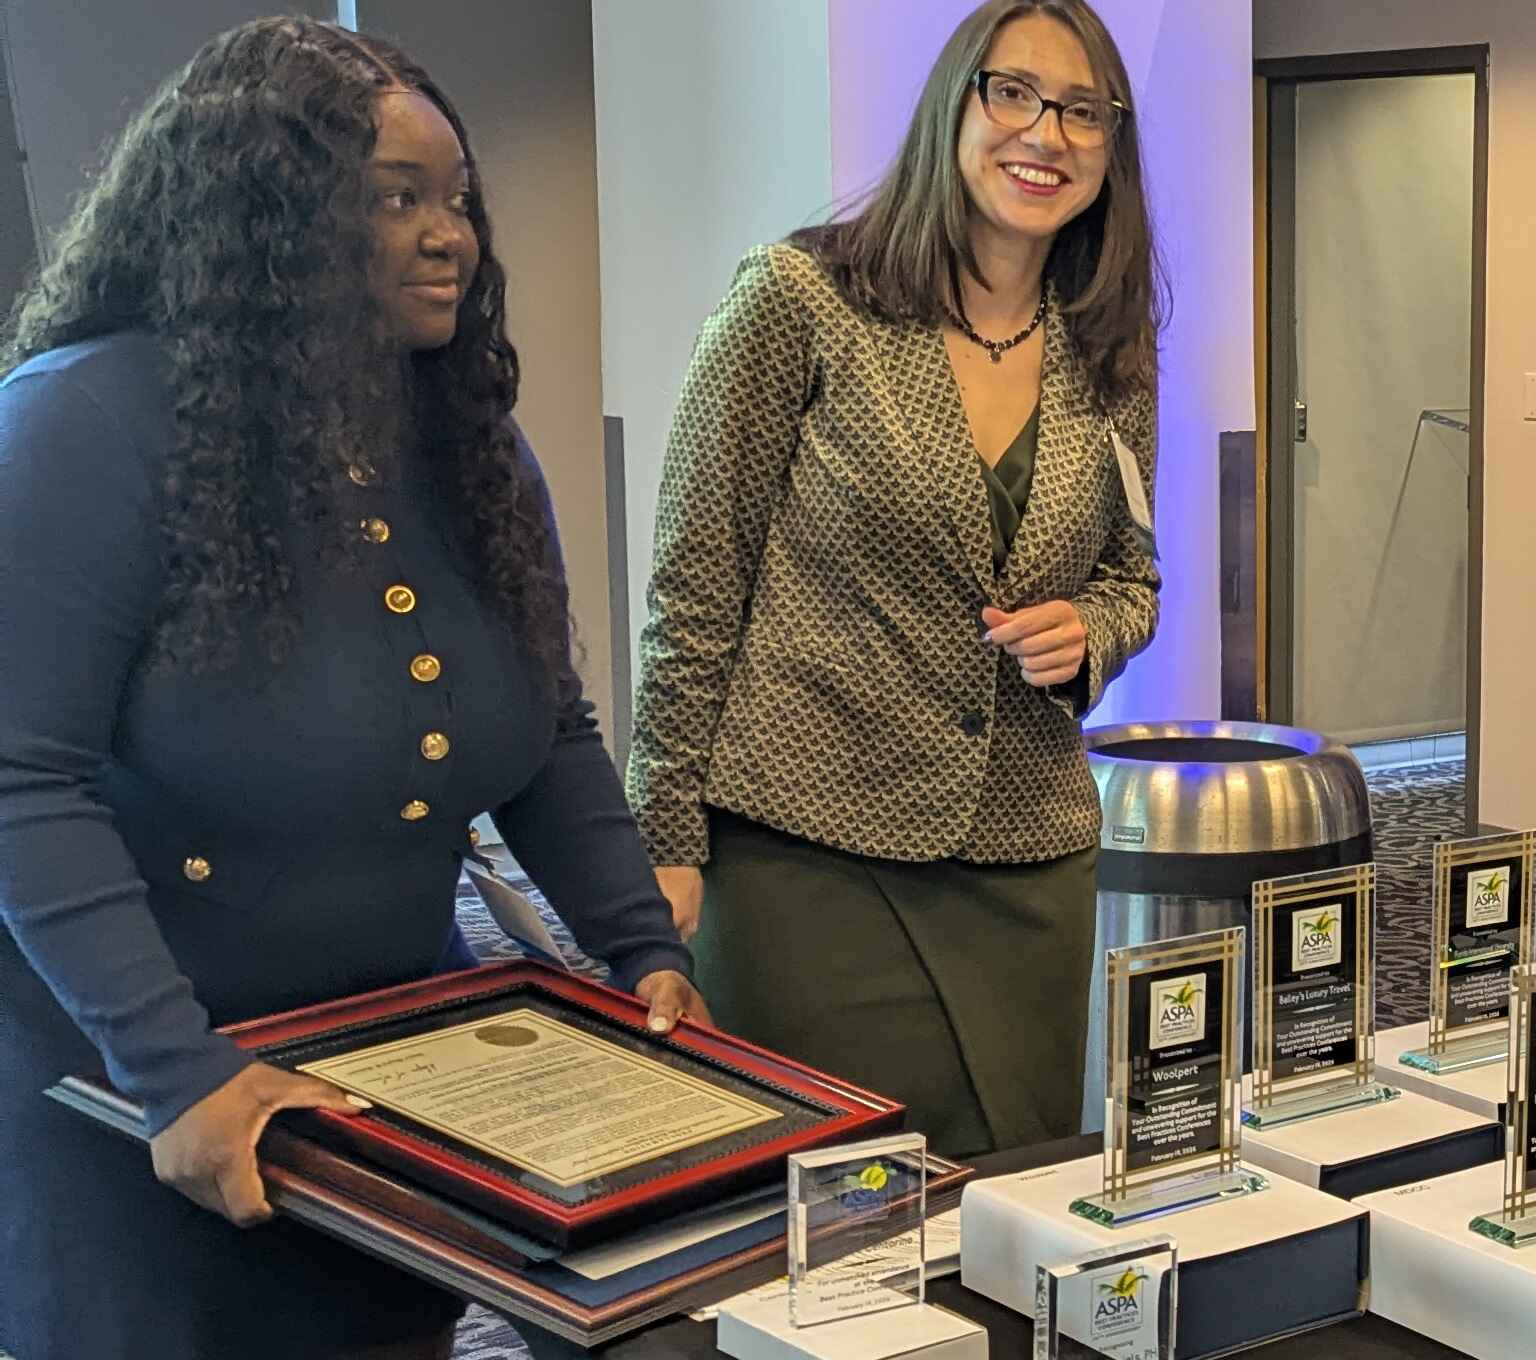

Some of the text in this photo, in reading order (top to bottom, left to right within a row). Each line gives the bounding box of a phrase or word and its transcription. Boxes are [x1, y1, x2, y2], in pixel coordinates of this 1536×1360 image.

[1475, 893, 1500, 906] ASPA
[1302, 933, 1332, 948] ASPA
[1306, 987, 1328, 1001] Luxury
[1330, 982, 1351, 995] Travel
[1161, 1006, 1194, 1023] ASPA
[1153, 1064, 1198, 1084] Woolpert
[1096, 1297, 1137, 1318] ASPA
